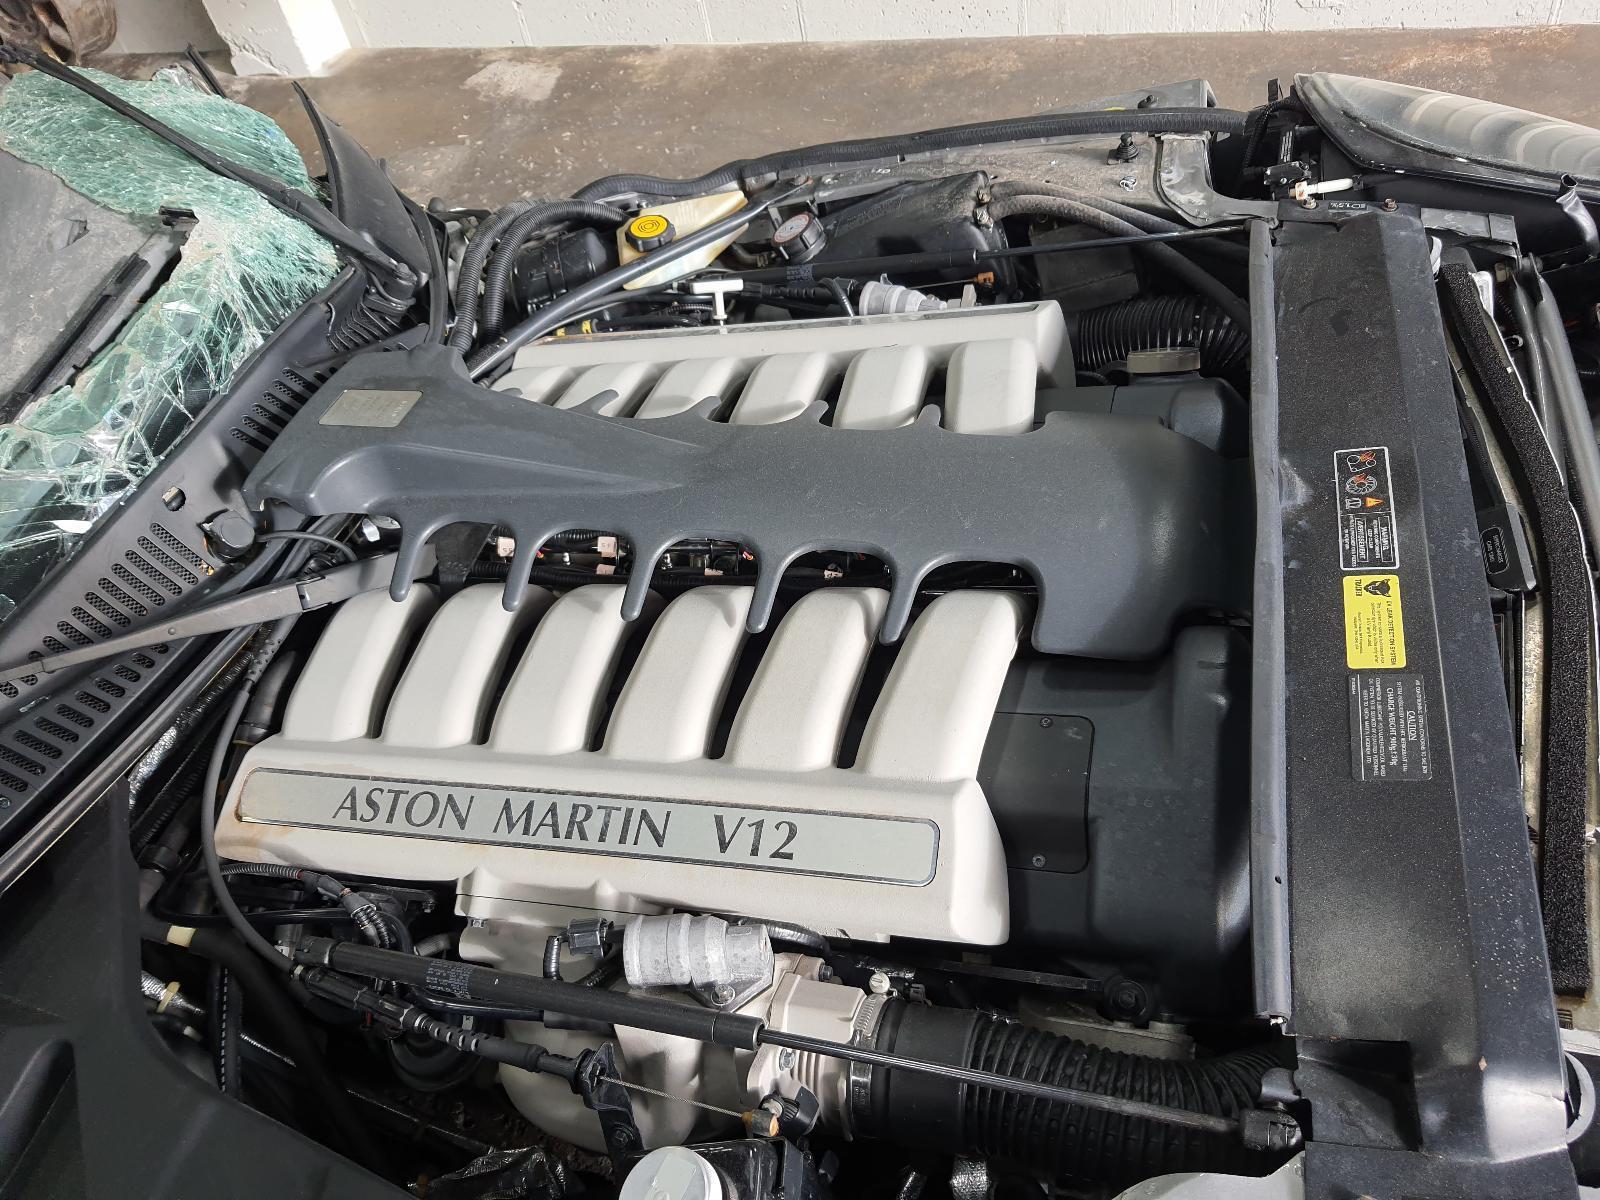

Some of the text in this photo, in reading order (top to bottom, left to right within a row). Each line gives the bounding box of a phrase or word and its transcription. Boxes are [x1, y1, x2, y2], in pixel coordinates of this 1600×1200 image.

[1387, 688, 1395, 711] CHARGE
[1388, 712, 1396, 735] WEIGHT
[1408, 711, 1417, 741] CAUTION
[332, 786, 798, 861] ASTON MARTIN V12
